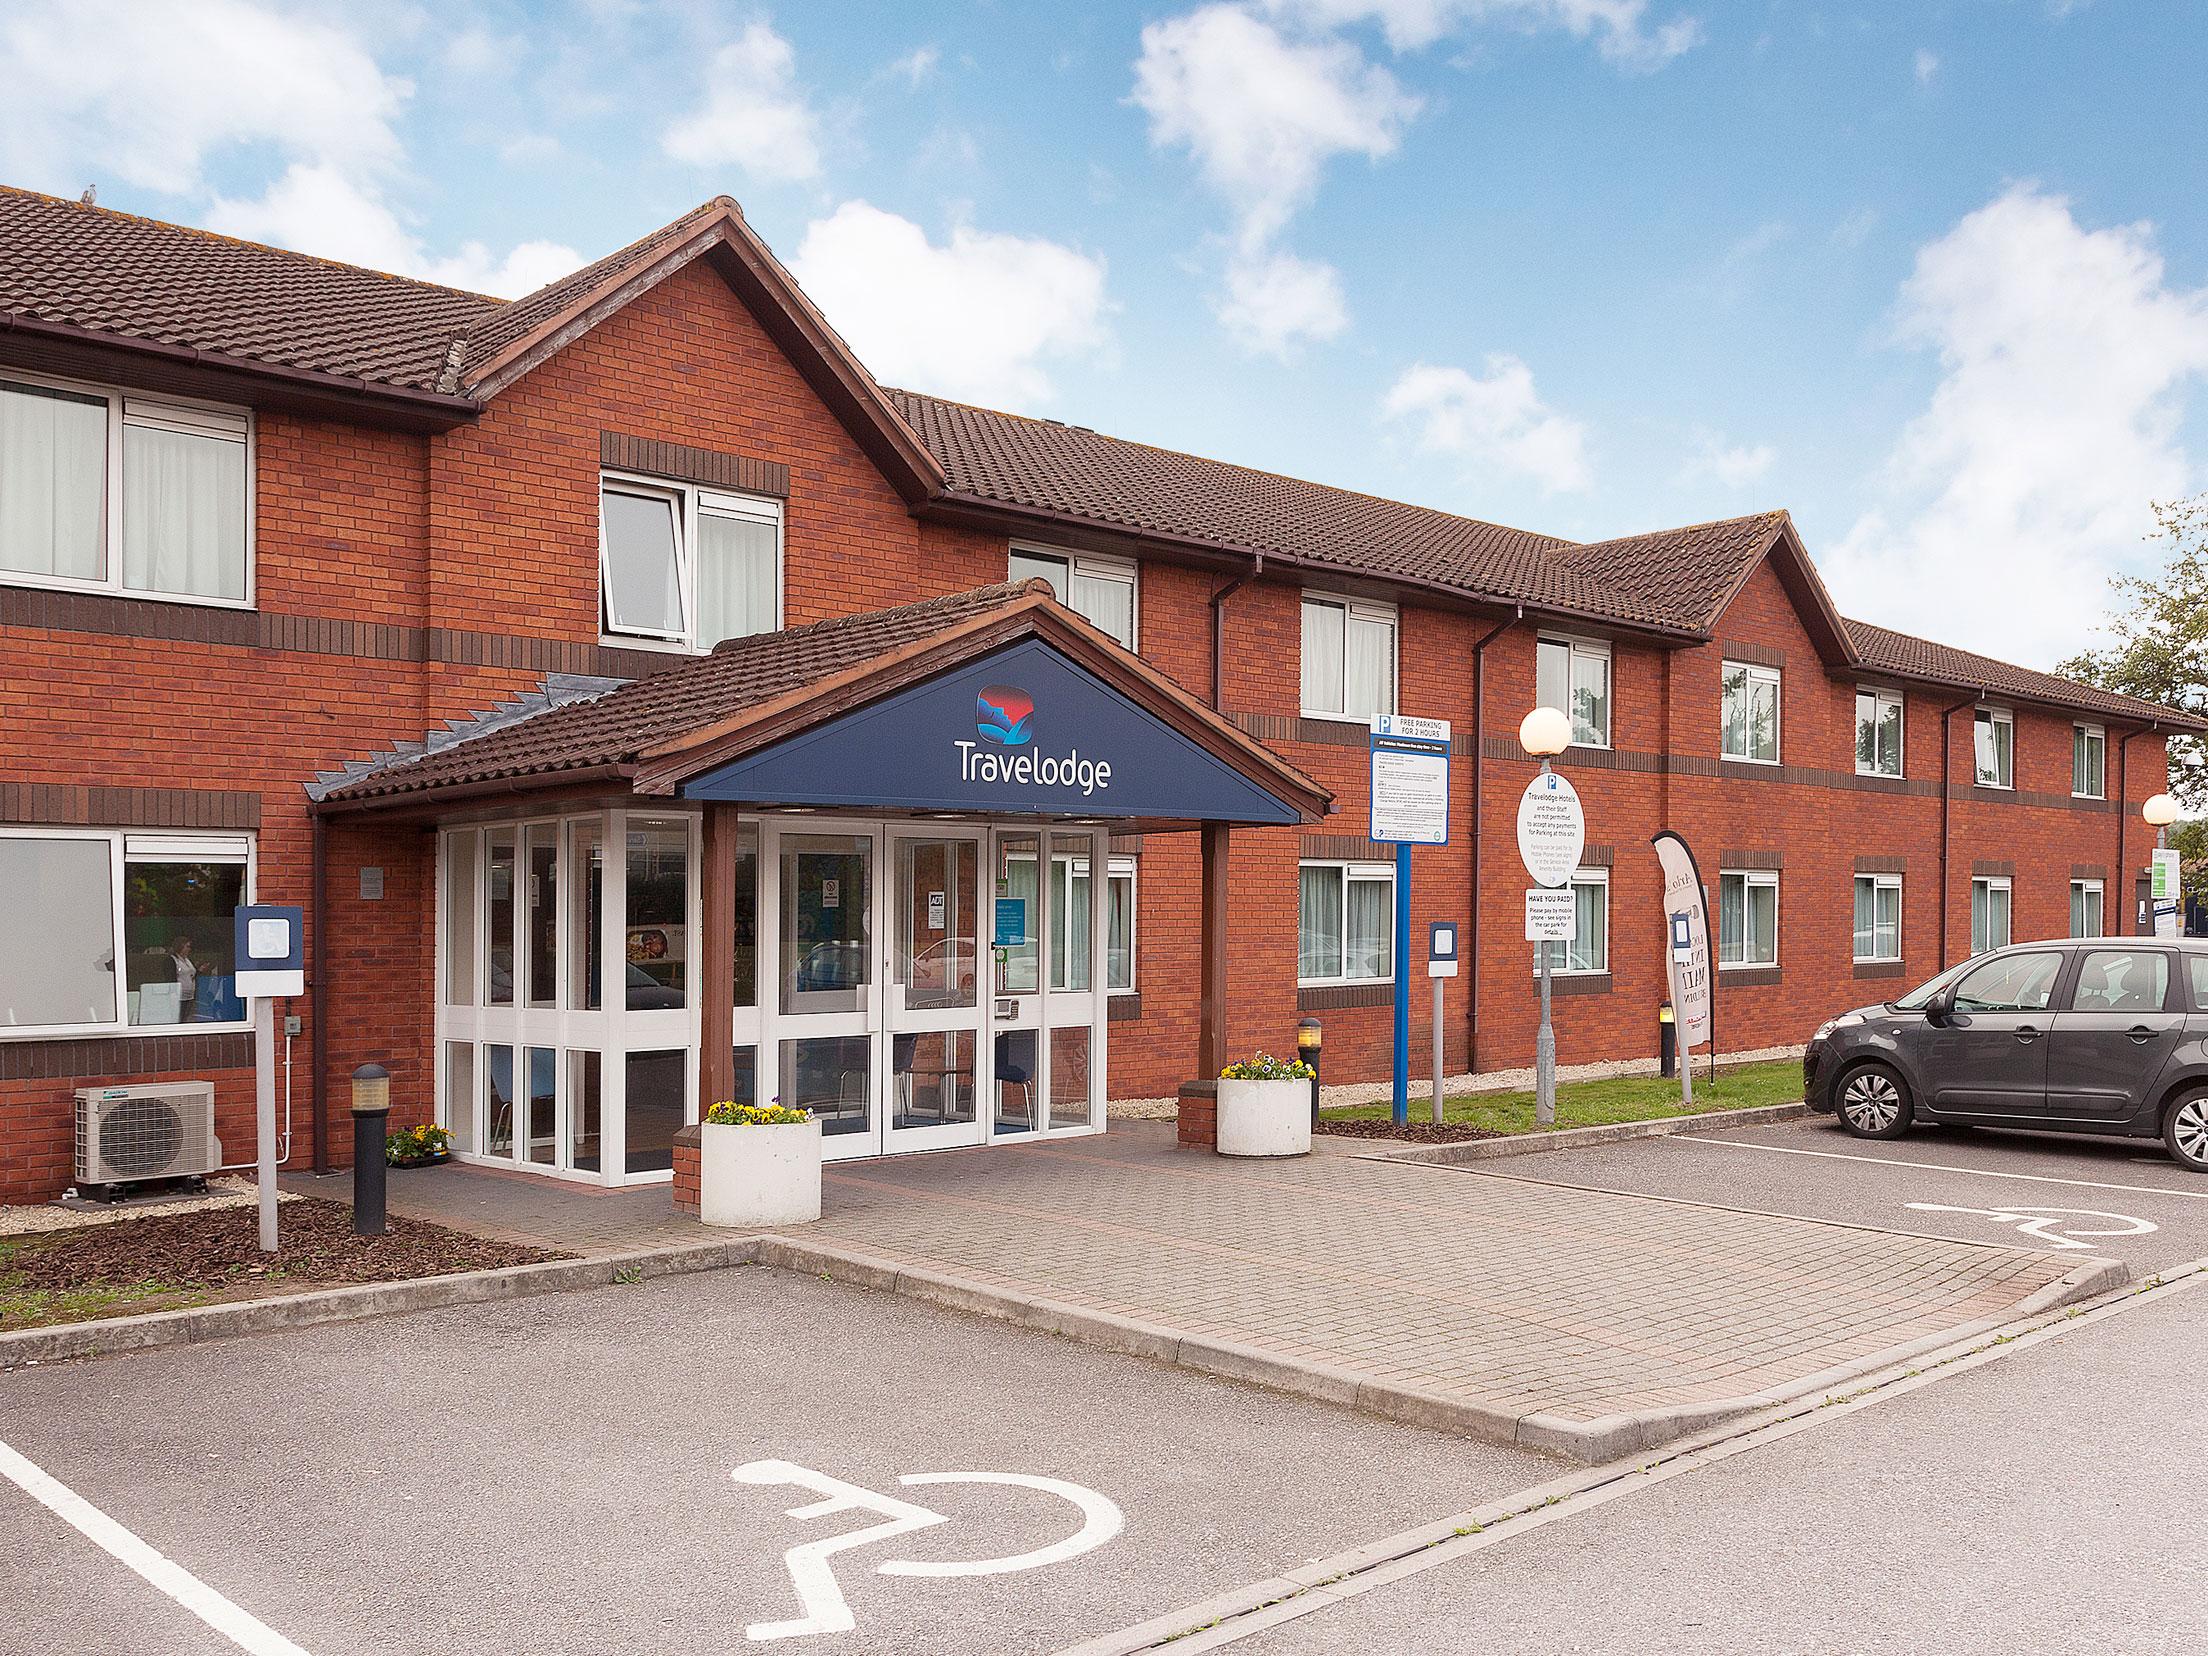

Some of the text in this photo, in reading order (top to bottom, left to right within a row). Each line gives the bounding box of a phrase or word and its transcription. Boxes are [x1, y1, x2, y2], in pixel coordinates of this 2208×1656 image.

[1400, 718, 1442, 730] FREE PARKING
[1420, 729, 1440, 738] HOURS
[954, 740, 1112, 796] Travelodge
[1529, 792, 1575, 803] Travelodge Hotels
[1536, 830, 1552, 838] Parking
